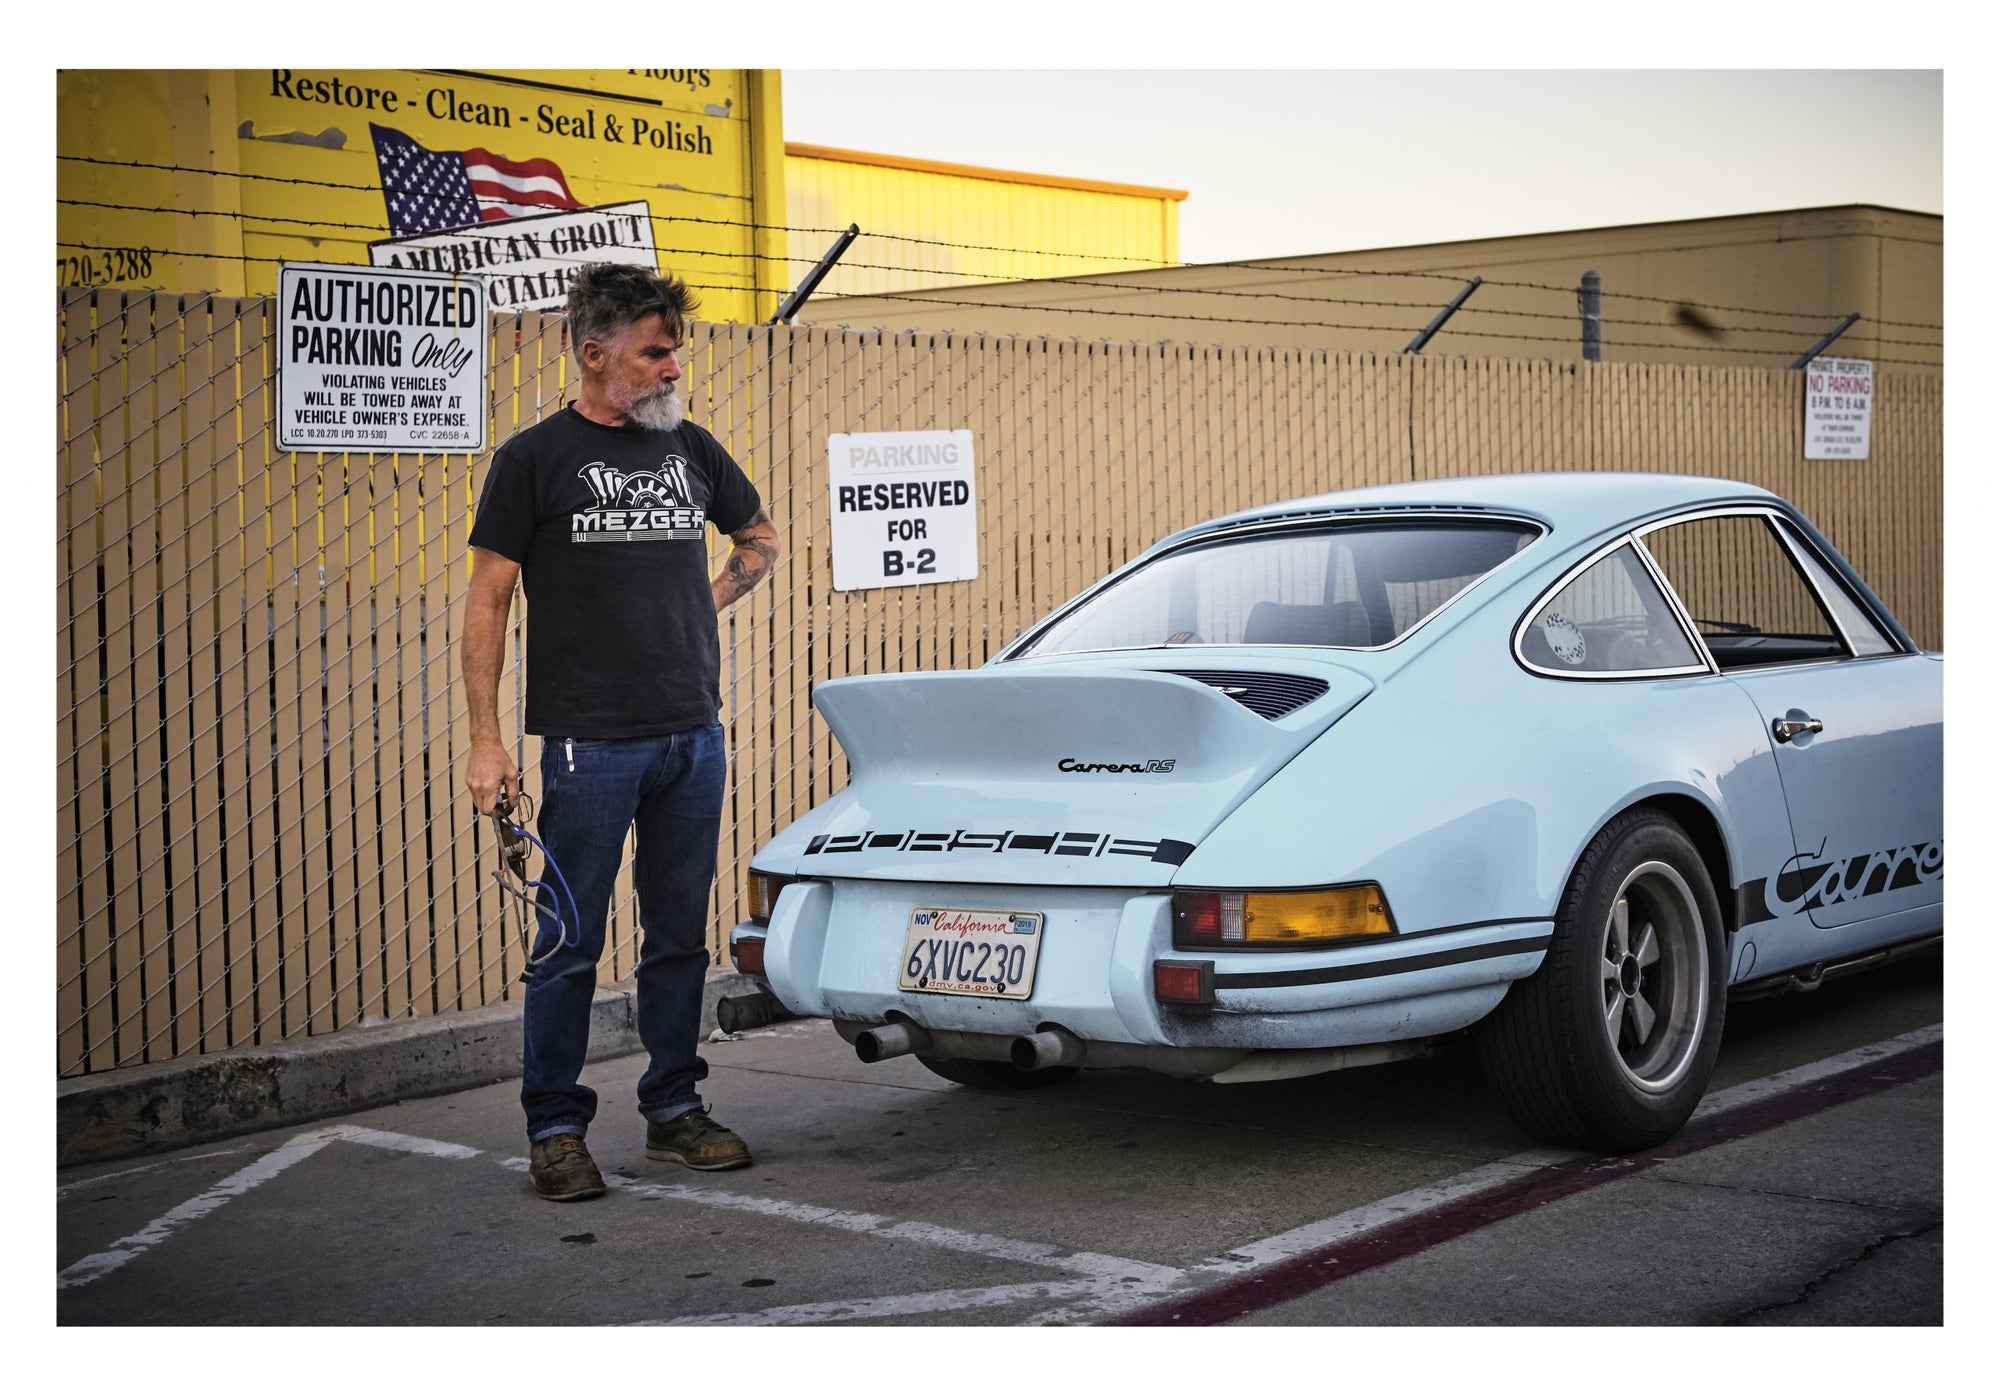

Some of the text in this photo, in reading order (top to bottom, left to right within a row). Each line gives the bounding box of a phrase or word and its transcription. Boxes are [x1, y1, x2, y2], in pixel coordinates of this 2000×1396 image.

[628, 69, 710, 87] oors
[270, 69, 398, 112] Restore
[426, 88, 511, 128] Clean
[537, 105, 596, 139] Seal
[604, 114, 624, 143] &
[632, 118, 713, 155] Polish
[391, 216, 643, 272] AMERICAN GROUT
[57, 246, 152, 286] 720-3288
[290, 277, 476, 328] AUTHORIZED
[292, 325, 473, 378] PARKING Only
[322, 374, 447, 391] VIOLATING VEHICLES
[1809, 374, 1870, 395] NO PARKING
[304, 391, 462, 409] WILL BE TOWED AWAY AT
[1834, 396, 1844, 410] TO
[295, 410, 470, 427] VEHICLE OWNER'S EXPENSE.
[291, 428, 304, 438] LCC
[307, 429, 338, 438] 10.20.270
[341, 429, 354, 439] LPD
[410, 430, 469, 440] CVC 22658-A
[849, 443, 959, 470] PARKING
[839, 480, 970, 512] RESERVED
[572, 510, 705, 531] MEZGER
[887, 518, 927, 542] FOR
[883, 548, 936, 577] B-2
[1058, 758, 1144, 773] Carrera
[810, 829, 1162, 860] PORSCHE
[914, 911, 1014, 938] NOV California
[1017, 919, 1031, 928] 2019
[906, 938, 1025, 985] 6XVC230
[929, 980, 996, 992] dmv.ca.gov
